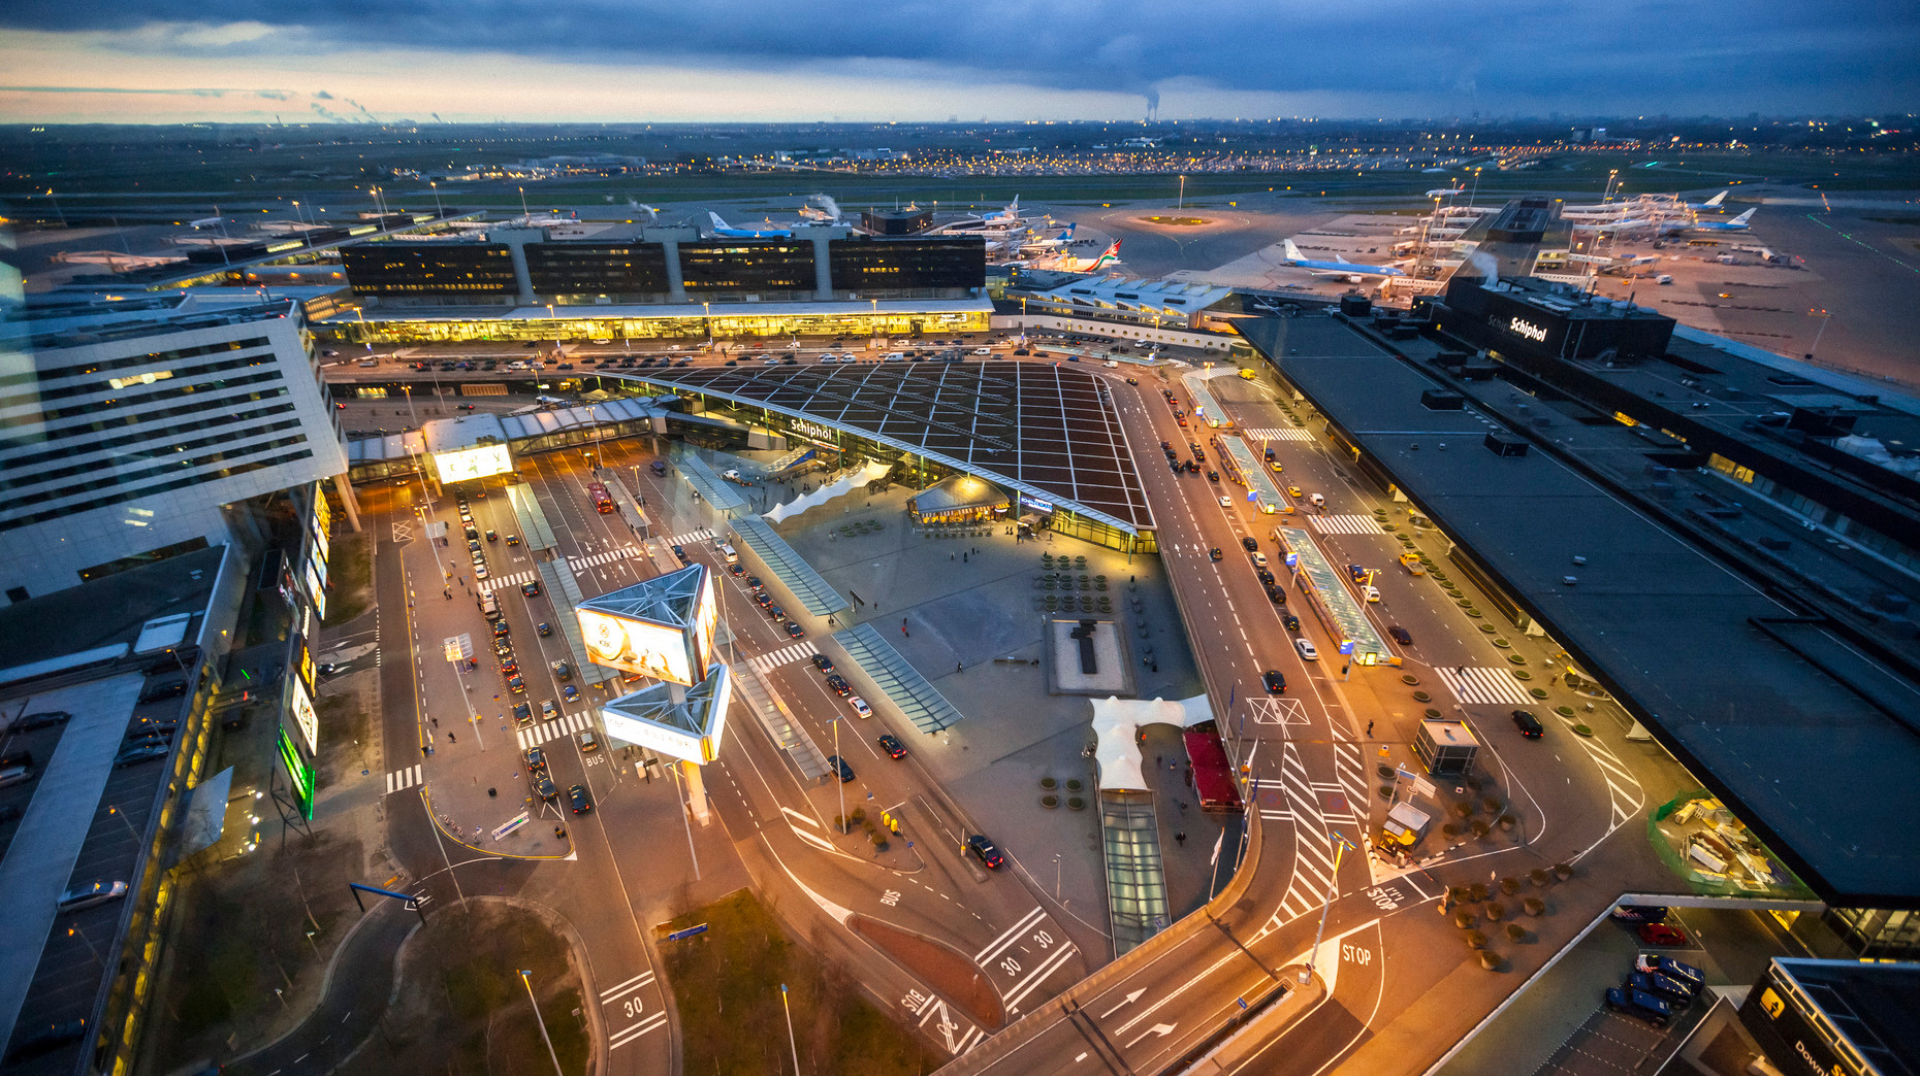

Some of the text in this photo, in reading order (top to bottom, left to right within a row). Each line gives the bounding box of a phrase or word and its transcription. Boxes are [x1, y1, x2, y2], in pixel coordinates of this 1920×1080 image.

[1510, 316, 1548, 342] Schiphol
[790, 419, 832, 440] Schiphol
[585, 754, 604, 767] BUS
[880, 889, 901, 907] BUS
[1366, 887, 1399, 910] STOP
[1033, 930, 1054, 949] 30
[1342, 944, 1371, 966] STOP
[1000, 956, 1022, 977] 30
[624, 996, 643, 1018] 30
[901, 988, 926, 1012] BUS
[1795, 1040, 1829, 1076] Down
